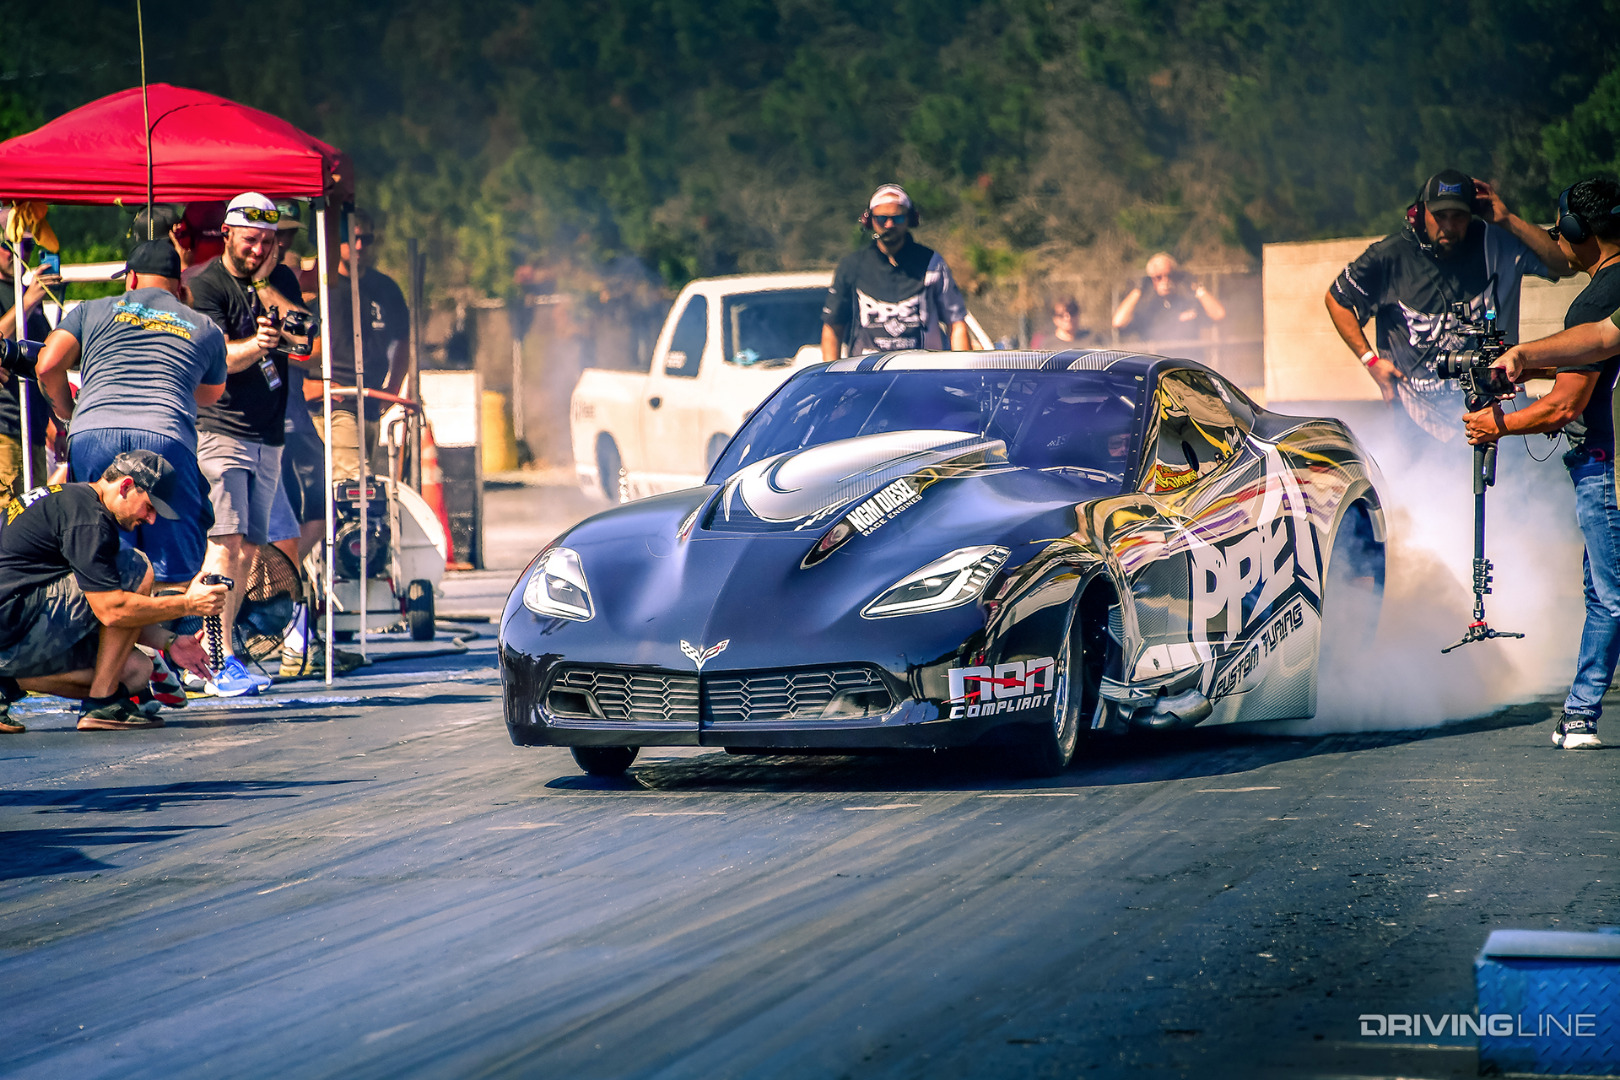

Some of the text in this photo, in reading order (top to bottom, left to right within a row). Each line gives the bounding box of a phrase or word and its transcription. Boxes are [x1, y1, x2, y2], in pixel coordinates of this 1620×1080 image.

[846, 498, 885, 532] NGM
[874, 478, 918, 514] DIESEL
[862, 495, 923, 537] RACE ENGINES
[1190, 515, 1296, 654] PPE
[1213, 601, 1304, 706] CUSTOM TUNING
[949, 693, 1052, 719] COMPLIANT
